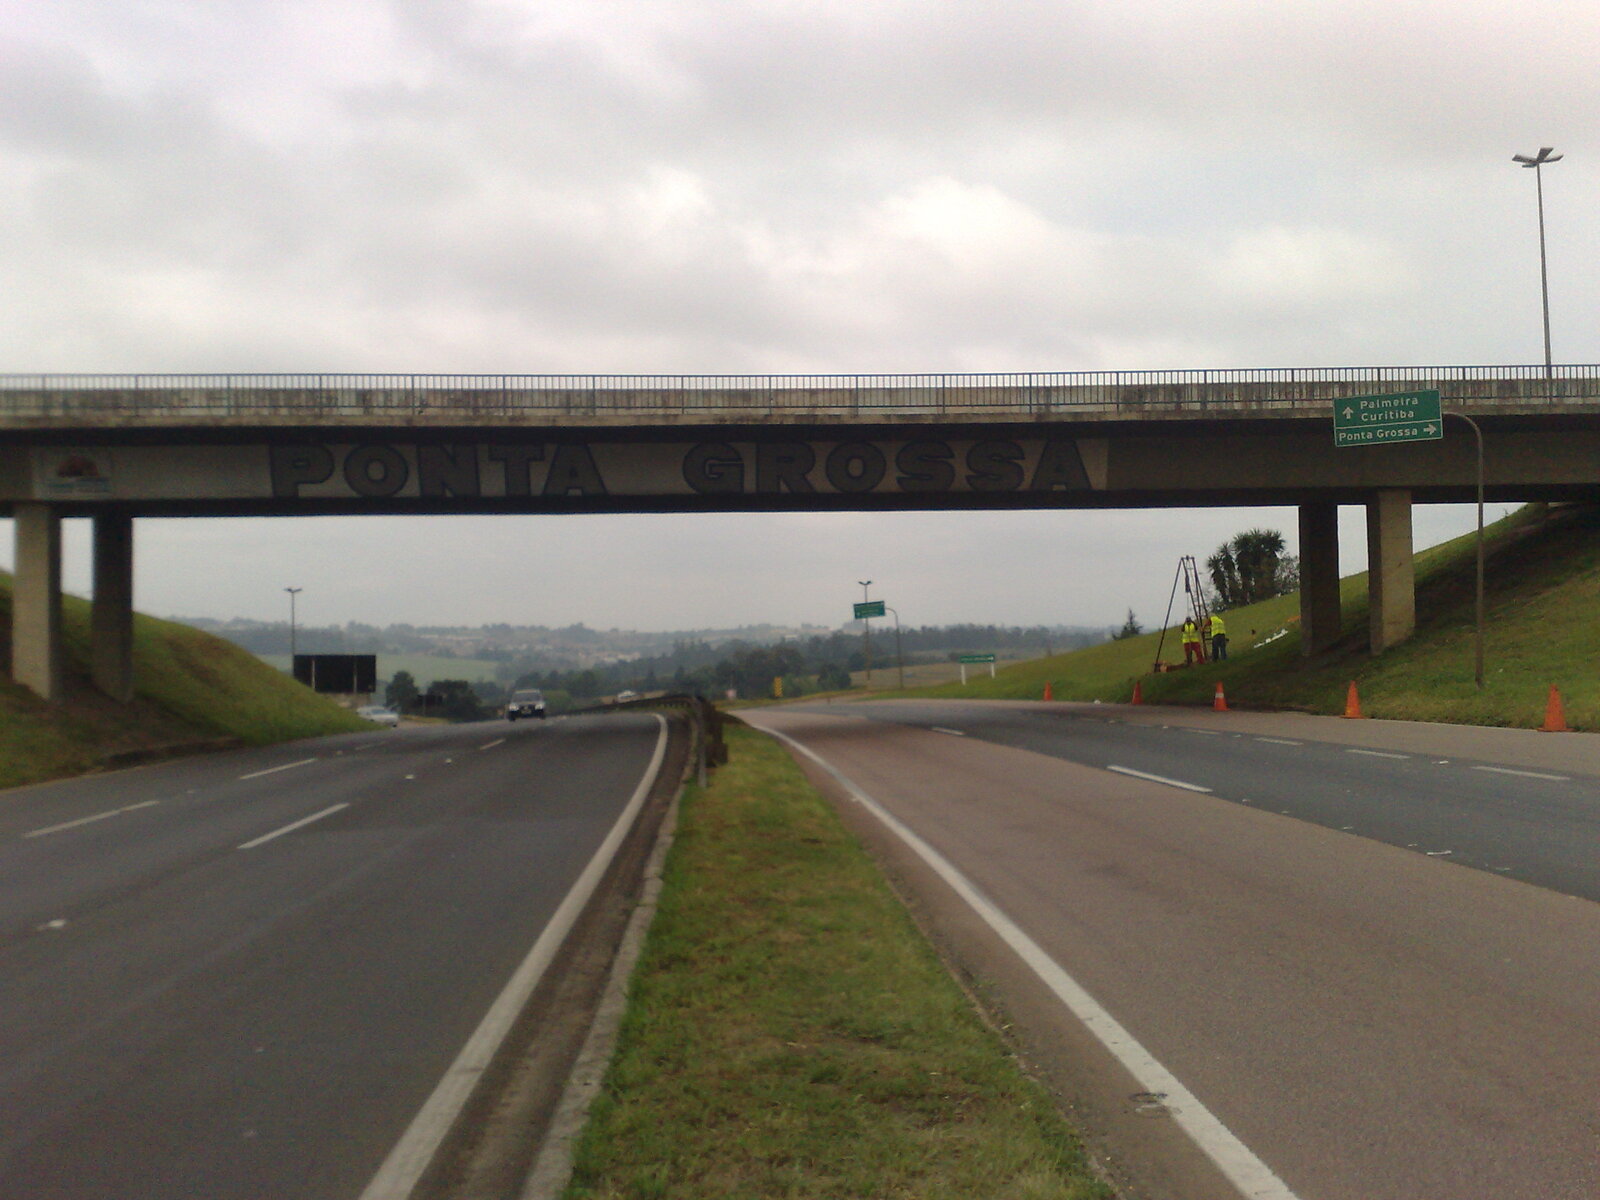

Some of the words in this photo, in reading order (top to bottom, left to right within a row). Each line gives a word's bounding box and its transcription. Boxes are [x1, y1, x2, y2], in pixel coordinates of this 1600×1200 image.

[1360, 396, 1419, 409] Palmeira
[1361, 410, 1415, 421] Curitiba
[1339, 430, 1373, 442] Ponta
[1376, 427, 1418, 438] Grossa
[269, 442, 609, 497] PONTA
[682, 439, 1092, 494] GROSSA
